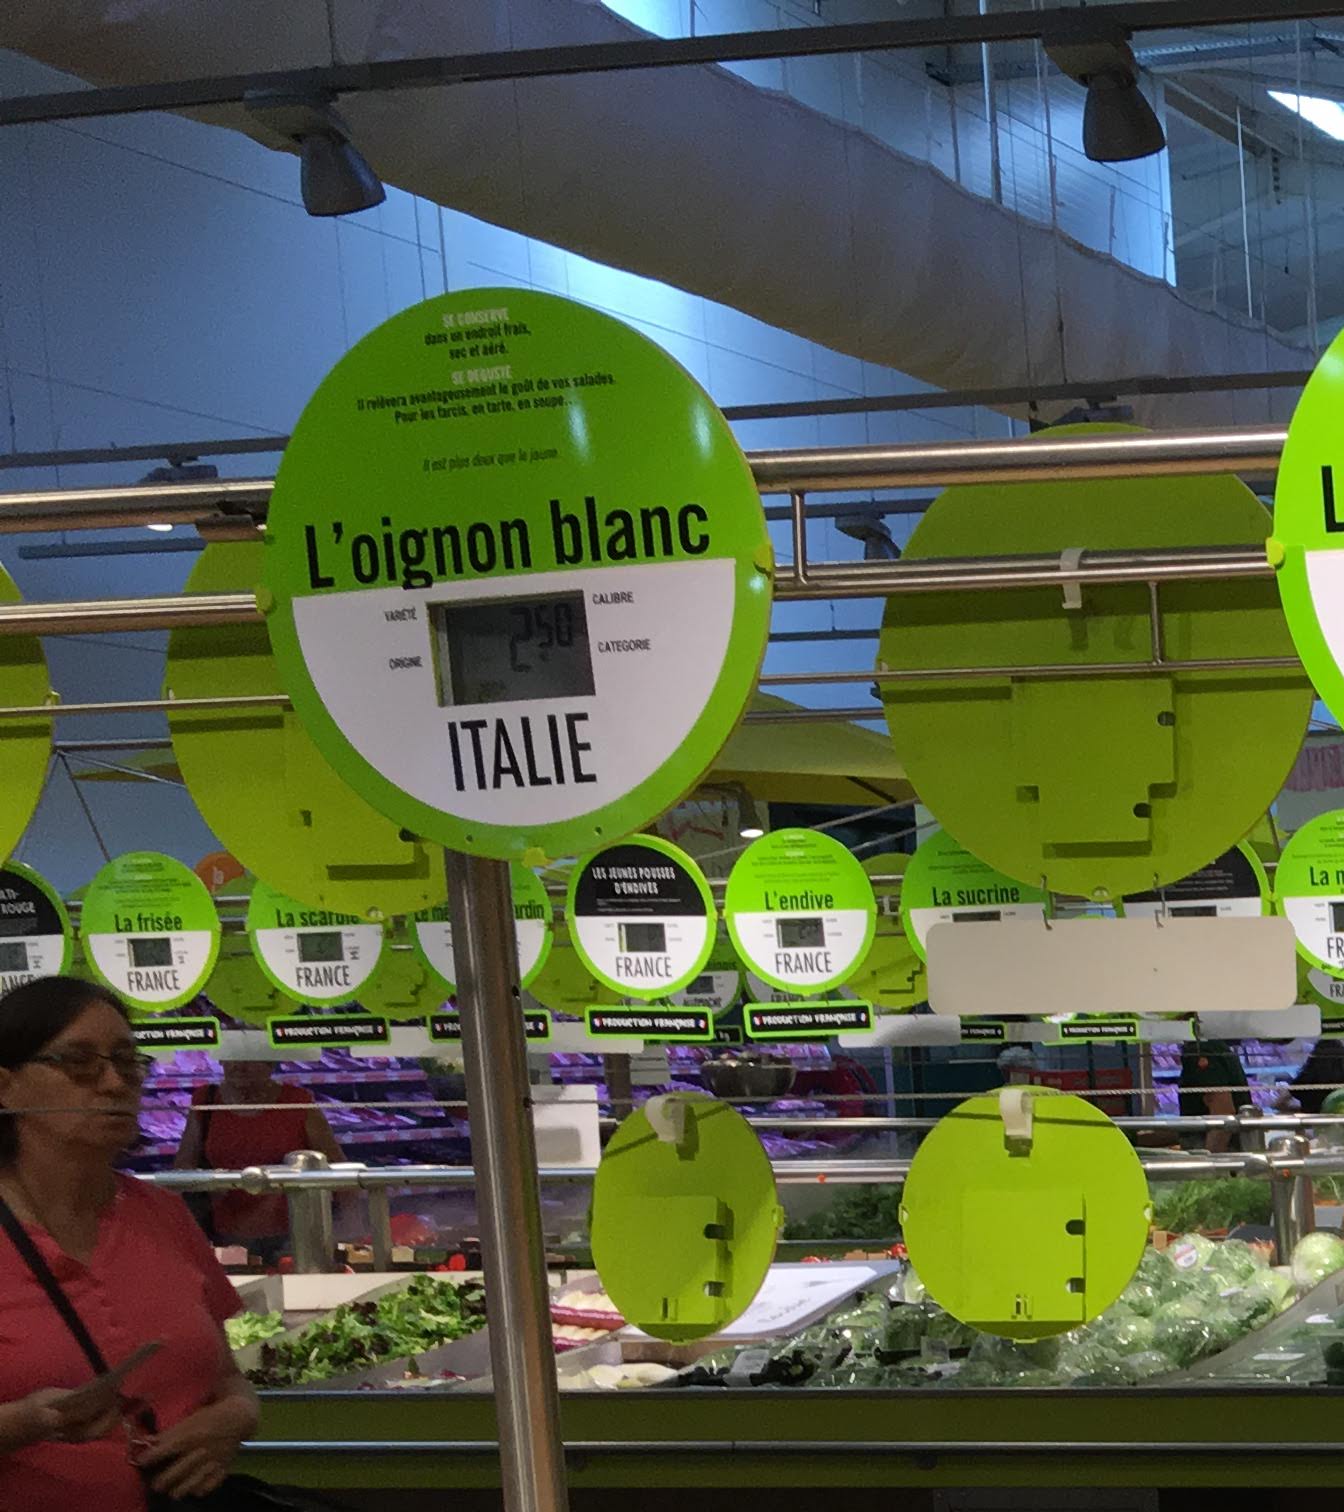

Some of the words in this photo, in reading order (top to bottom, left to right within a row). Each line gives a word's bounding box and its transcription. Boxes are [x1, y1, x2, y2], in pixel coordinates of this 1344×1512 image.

[304, 516, 532, 590] L'oignon
[549, 496, 710, 566] blanc
[592, 591, 634, 605] CALIBRE
[597, 638, 651, 654] CATEGORIE
[447, 713, 597, 792] ITALIE
[608, 866, 637, 880] JEUNES
[639, 866, 675, 880] POUSSES
[1310, 866, 1329, 886] La
[764, 890, 834, 911] L'endive
[932, 887, 952, 907] La
[956, 884, 1020, 905] sucrine
[115, 914, 132, 933] La
[137, 912, 183, 931] frisée
[276, 909, 295, 927] La
[616, 957, 672, 978] FRANCE
[775, 952, 832, 974] FRANCE
[127, 970, 181, 992] FRANCE
[296, 965, 350, 987] FRANCE
